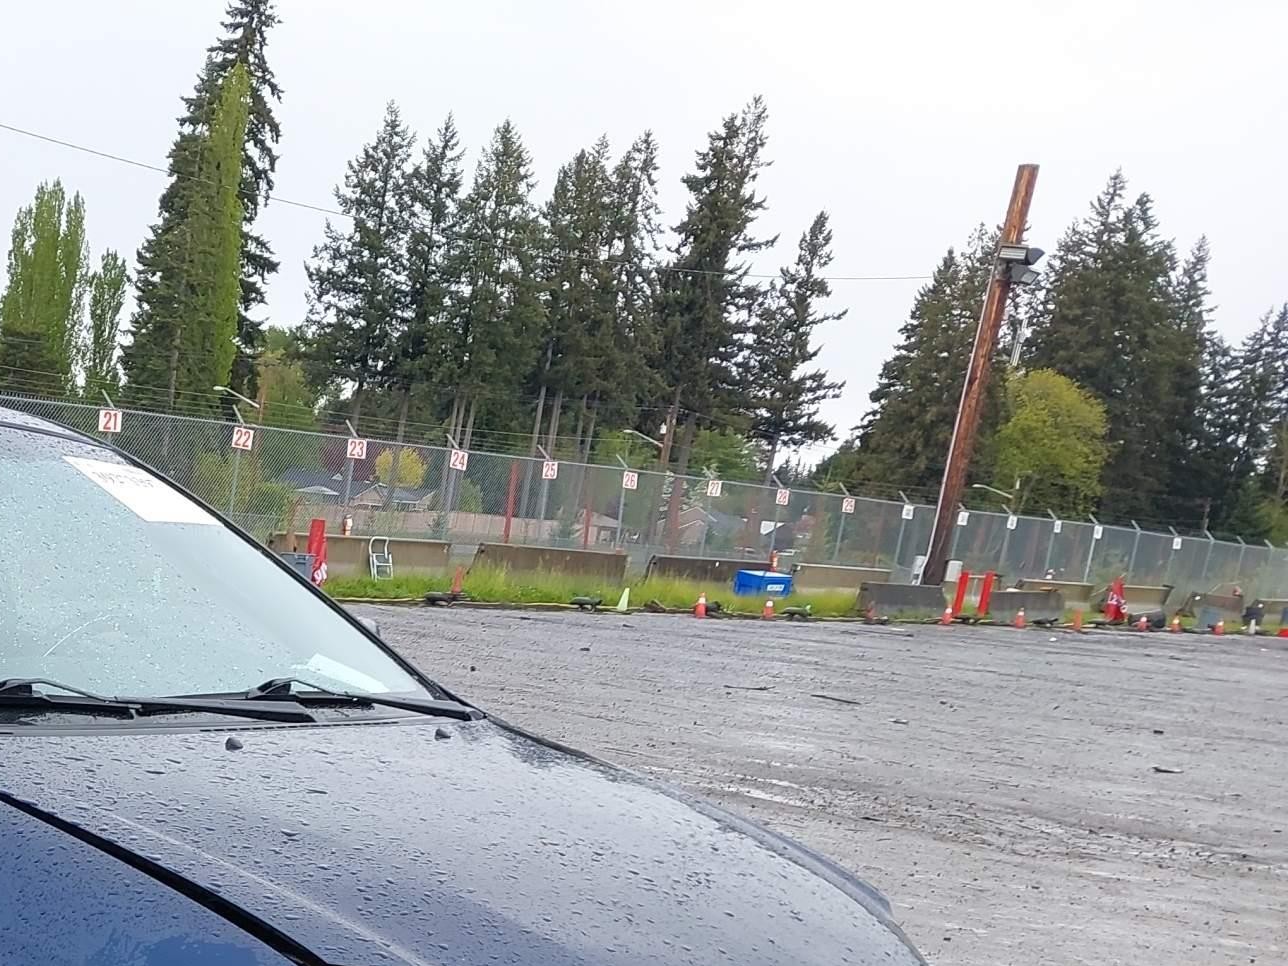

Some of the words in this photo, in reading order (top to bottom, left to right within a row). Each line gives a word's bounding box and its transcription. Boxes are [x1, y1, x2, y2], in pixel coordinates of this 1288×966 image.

[103, 411, 118, 430] 21
[235, 429, 251, 448] 22
[349, 441, 364, 457] 23
[452, 452, 466, 468] 24
[543, 463, 556, 478] 25
[624, 473, 636, 487] 26
